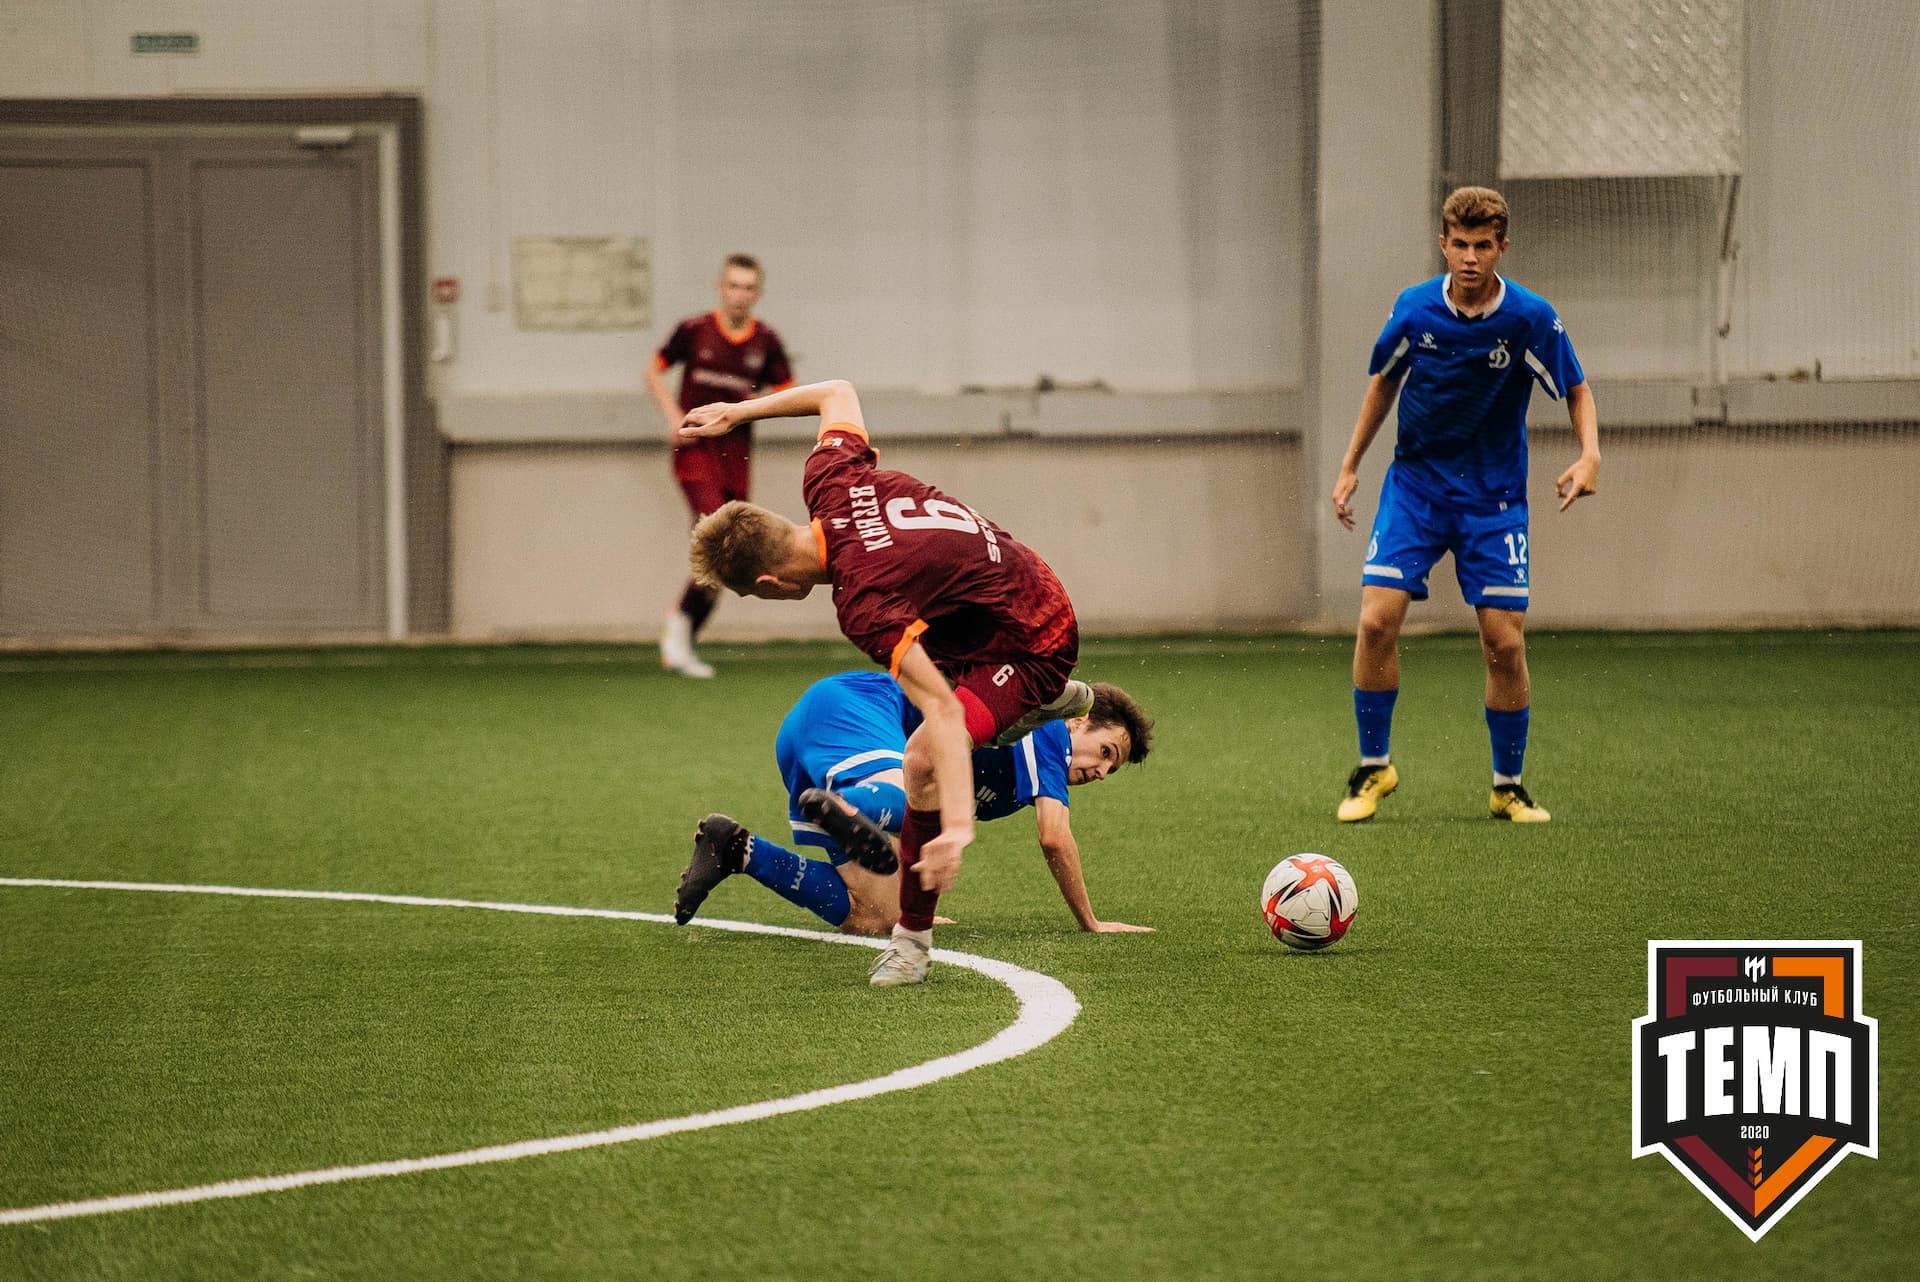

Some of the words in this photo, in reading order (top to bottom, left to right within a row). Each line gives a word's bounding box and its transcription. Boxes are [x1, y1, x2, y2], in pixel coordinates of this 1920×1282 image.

[848, 485, 895, 553] КНЯЗЕВ
[885, 497, 980, 535] 6
[1504, 533, 1529, 565] 12
[991, 663, 1015, 687] 6
